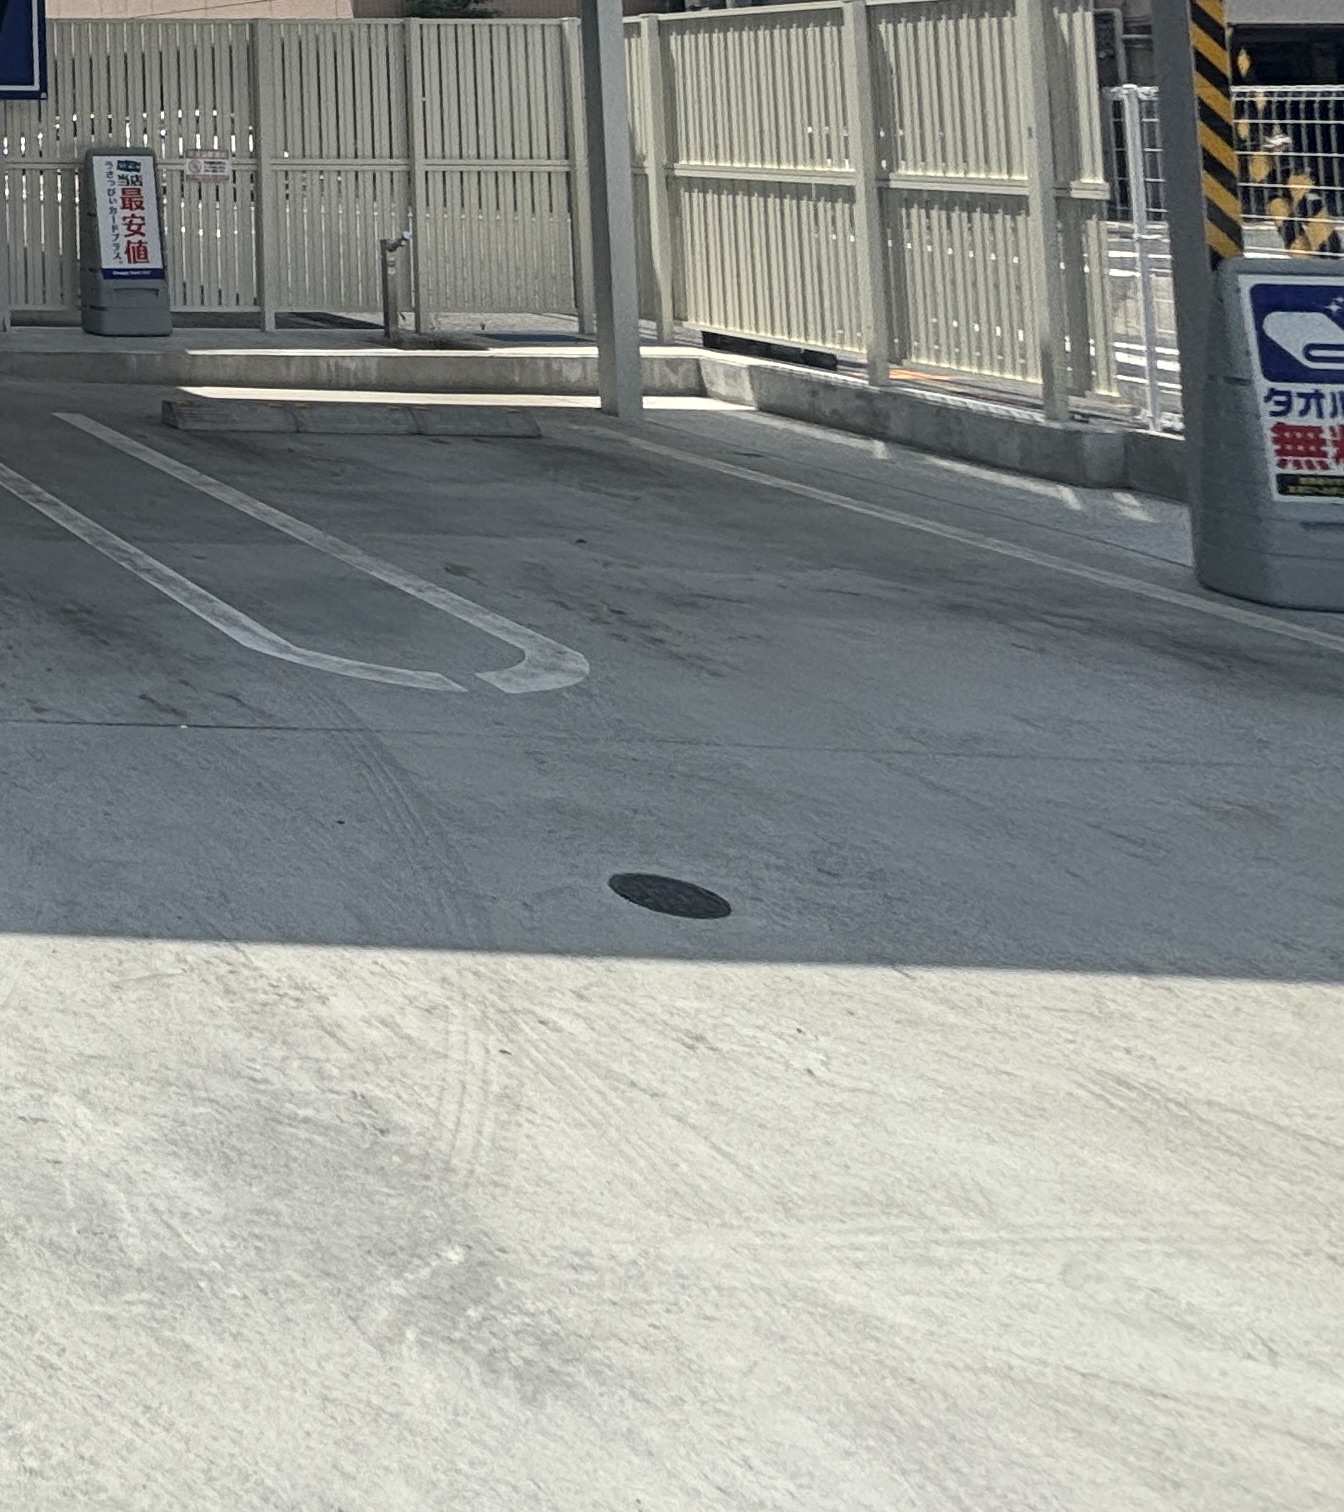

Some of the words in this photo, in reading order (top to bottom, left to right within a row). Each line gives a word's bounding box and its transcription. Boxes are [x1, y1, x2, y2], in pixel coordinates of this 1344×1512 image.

[117, 173, 144, 187] 当店
[120, 188, 150, 265] 最安値
[1263, 387, 1344, 419] タオル
